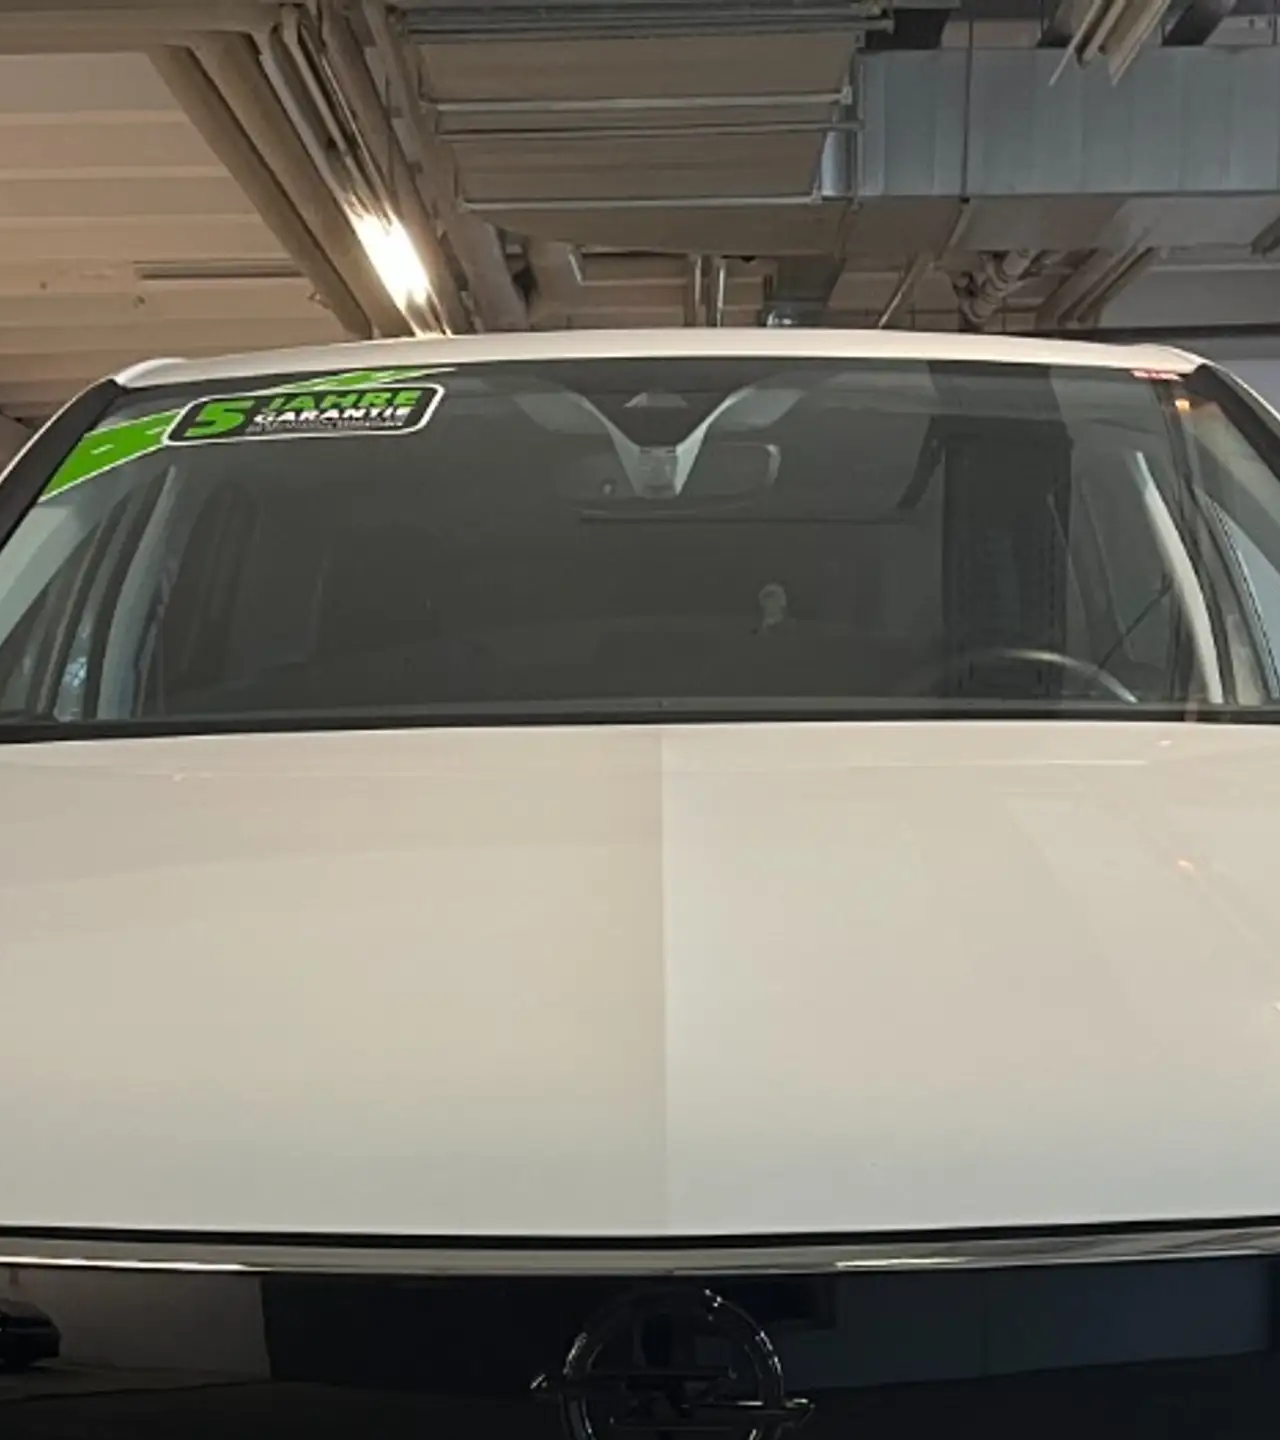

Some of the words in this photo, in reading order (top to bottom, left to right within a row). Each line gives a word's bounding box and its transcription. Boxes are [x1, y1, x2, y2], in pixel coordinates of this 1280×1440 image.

[183, 399, 255, 438] 5
[262, 390, 423, 413] JAHRE
[252, 405, 414, 425] GARANTIE
